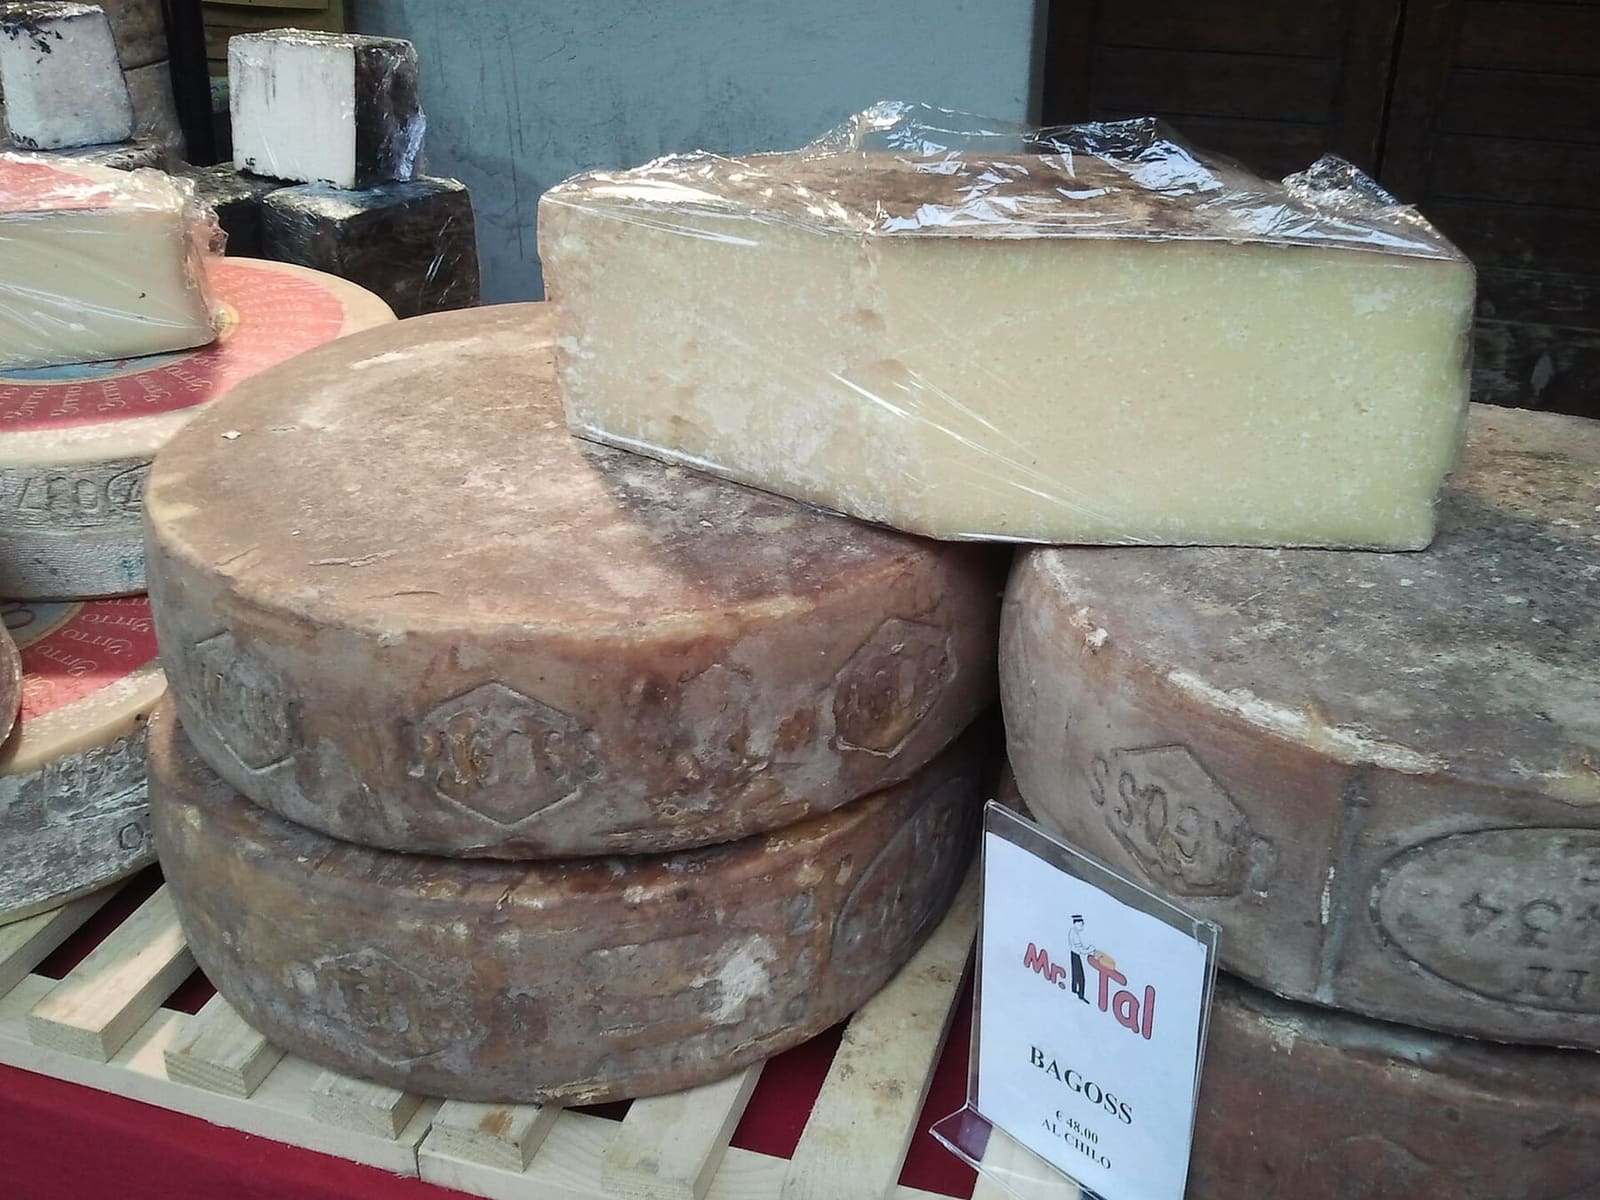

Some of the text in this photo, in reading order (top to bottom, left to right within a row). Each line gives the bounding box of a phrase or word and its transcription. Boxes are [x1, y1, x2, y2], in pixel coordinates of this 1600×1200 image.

[1024, 942, 1156, 1041] Mr. Tal
[1030, 1046, 1132, 1125] BAGOSS
[1041, 1119, 1111, 1170] AL CHILO
[1066, 1118, 1099, 1145] 48.00
